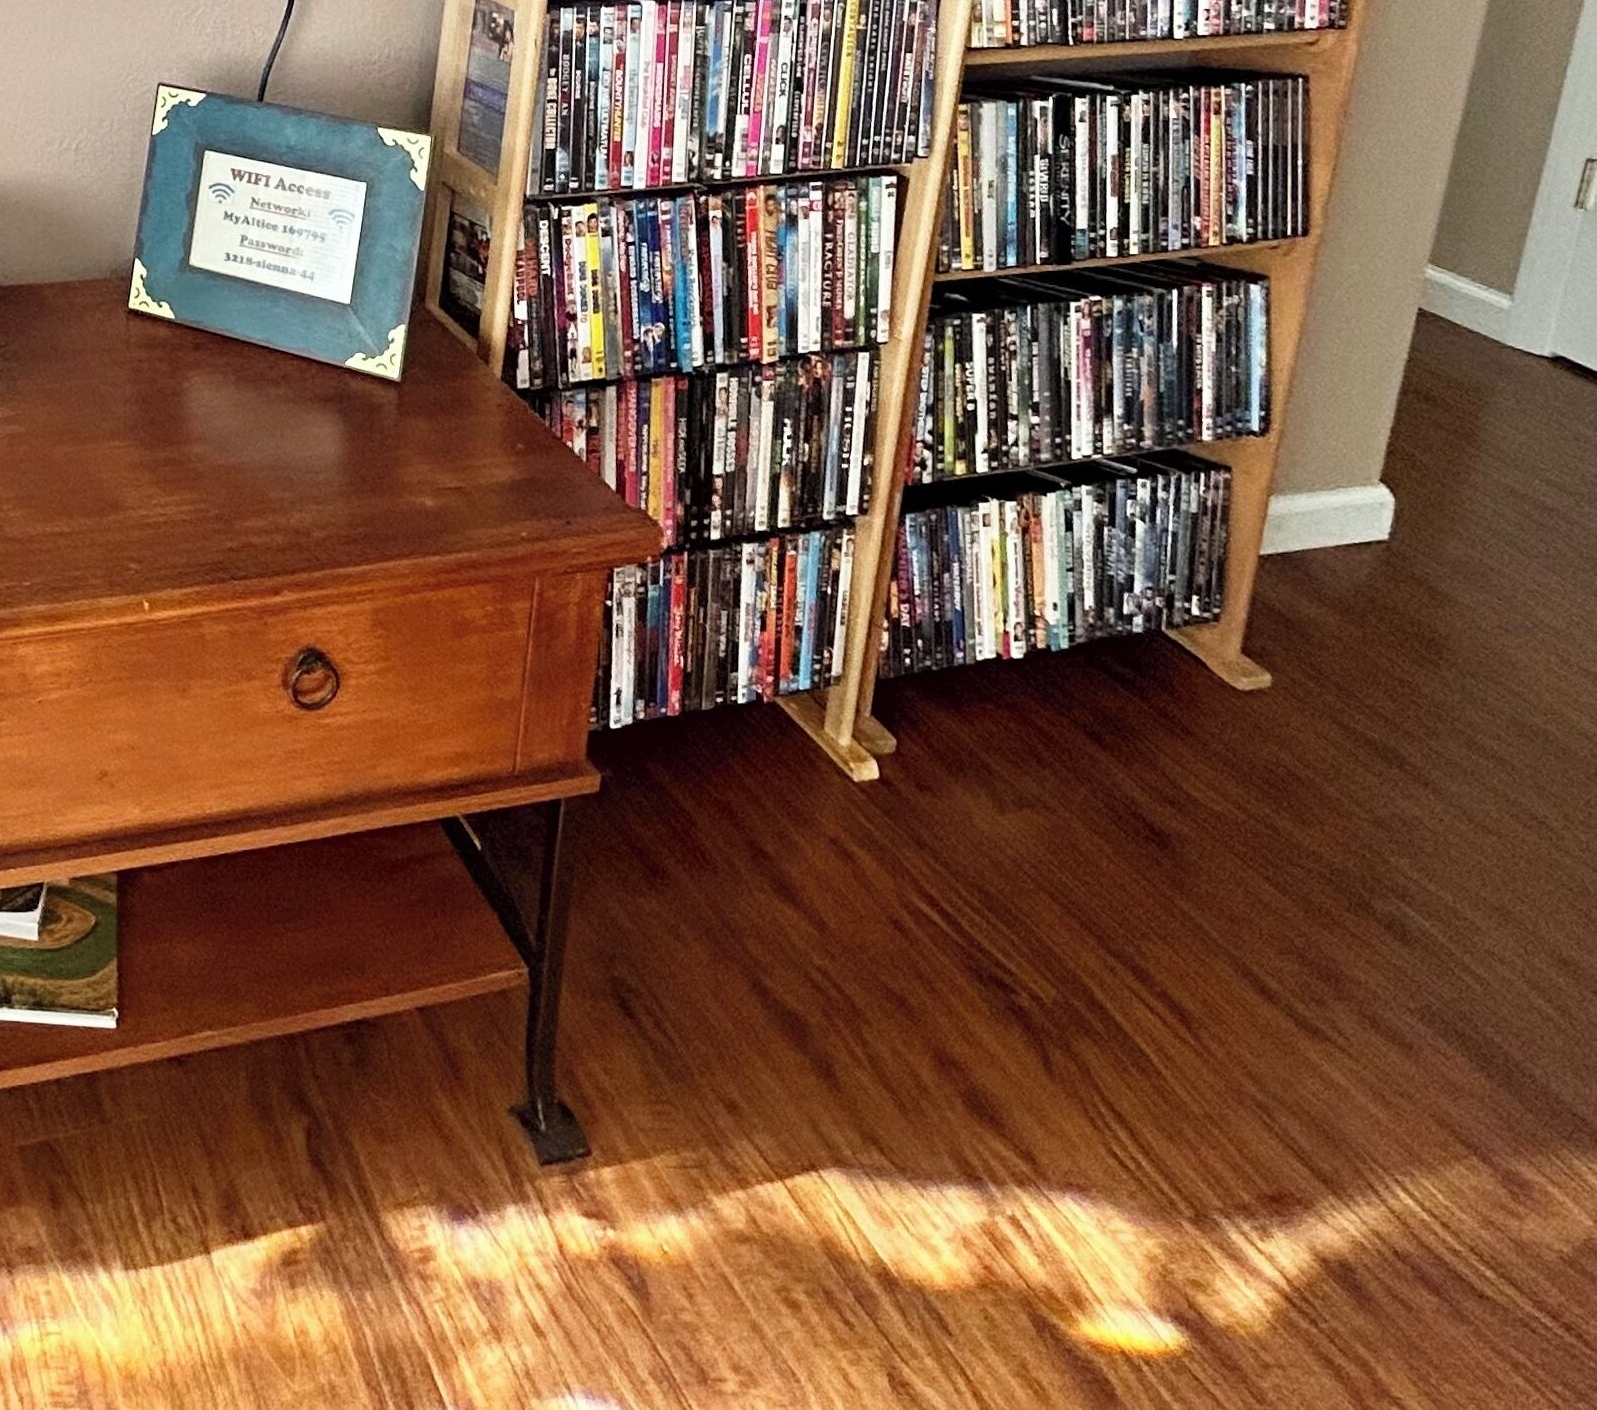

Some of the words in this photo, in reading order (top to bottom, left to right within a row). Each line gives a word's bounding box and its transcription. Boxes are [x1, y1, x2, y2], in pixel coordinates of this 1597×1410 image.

[740, 53, 751, 115] CELLUL
[778, 61, 788, 97] CLICK
[230, 168, 271, 187] WIFI
[539, 220, 550, 276] DESCENT
